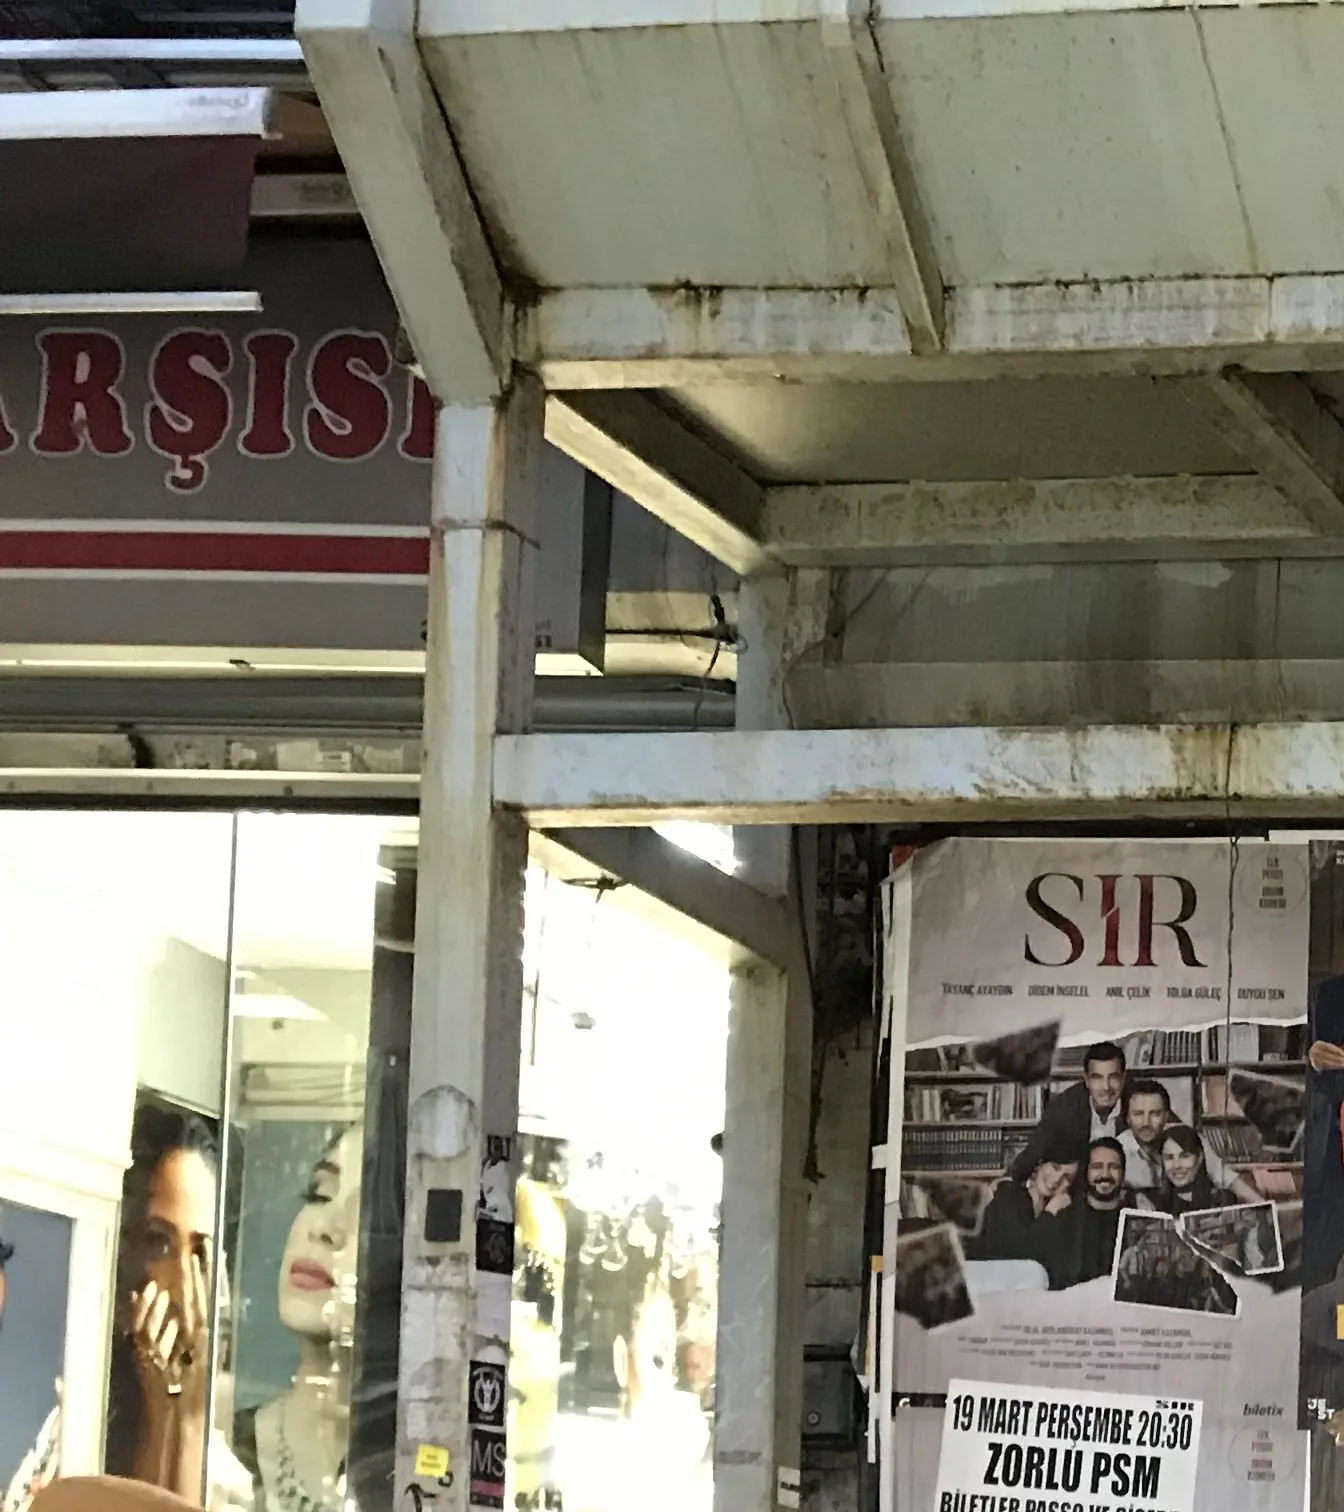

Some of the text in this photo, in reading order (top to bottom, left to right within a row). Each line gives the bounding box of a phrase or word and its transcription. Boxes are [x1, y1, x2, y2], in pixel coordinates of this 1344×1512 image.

[0, 328, 434, 494] RŞIS
[1024, 872, 1207, 968] SIR
[953, 1395, 1192, 1451] 19 MART PERŞEMBE 20:30
[1243, 1403, 1285, 1417] biletix
[983, 1442, 1161, 1499] ZORLU PSM
